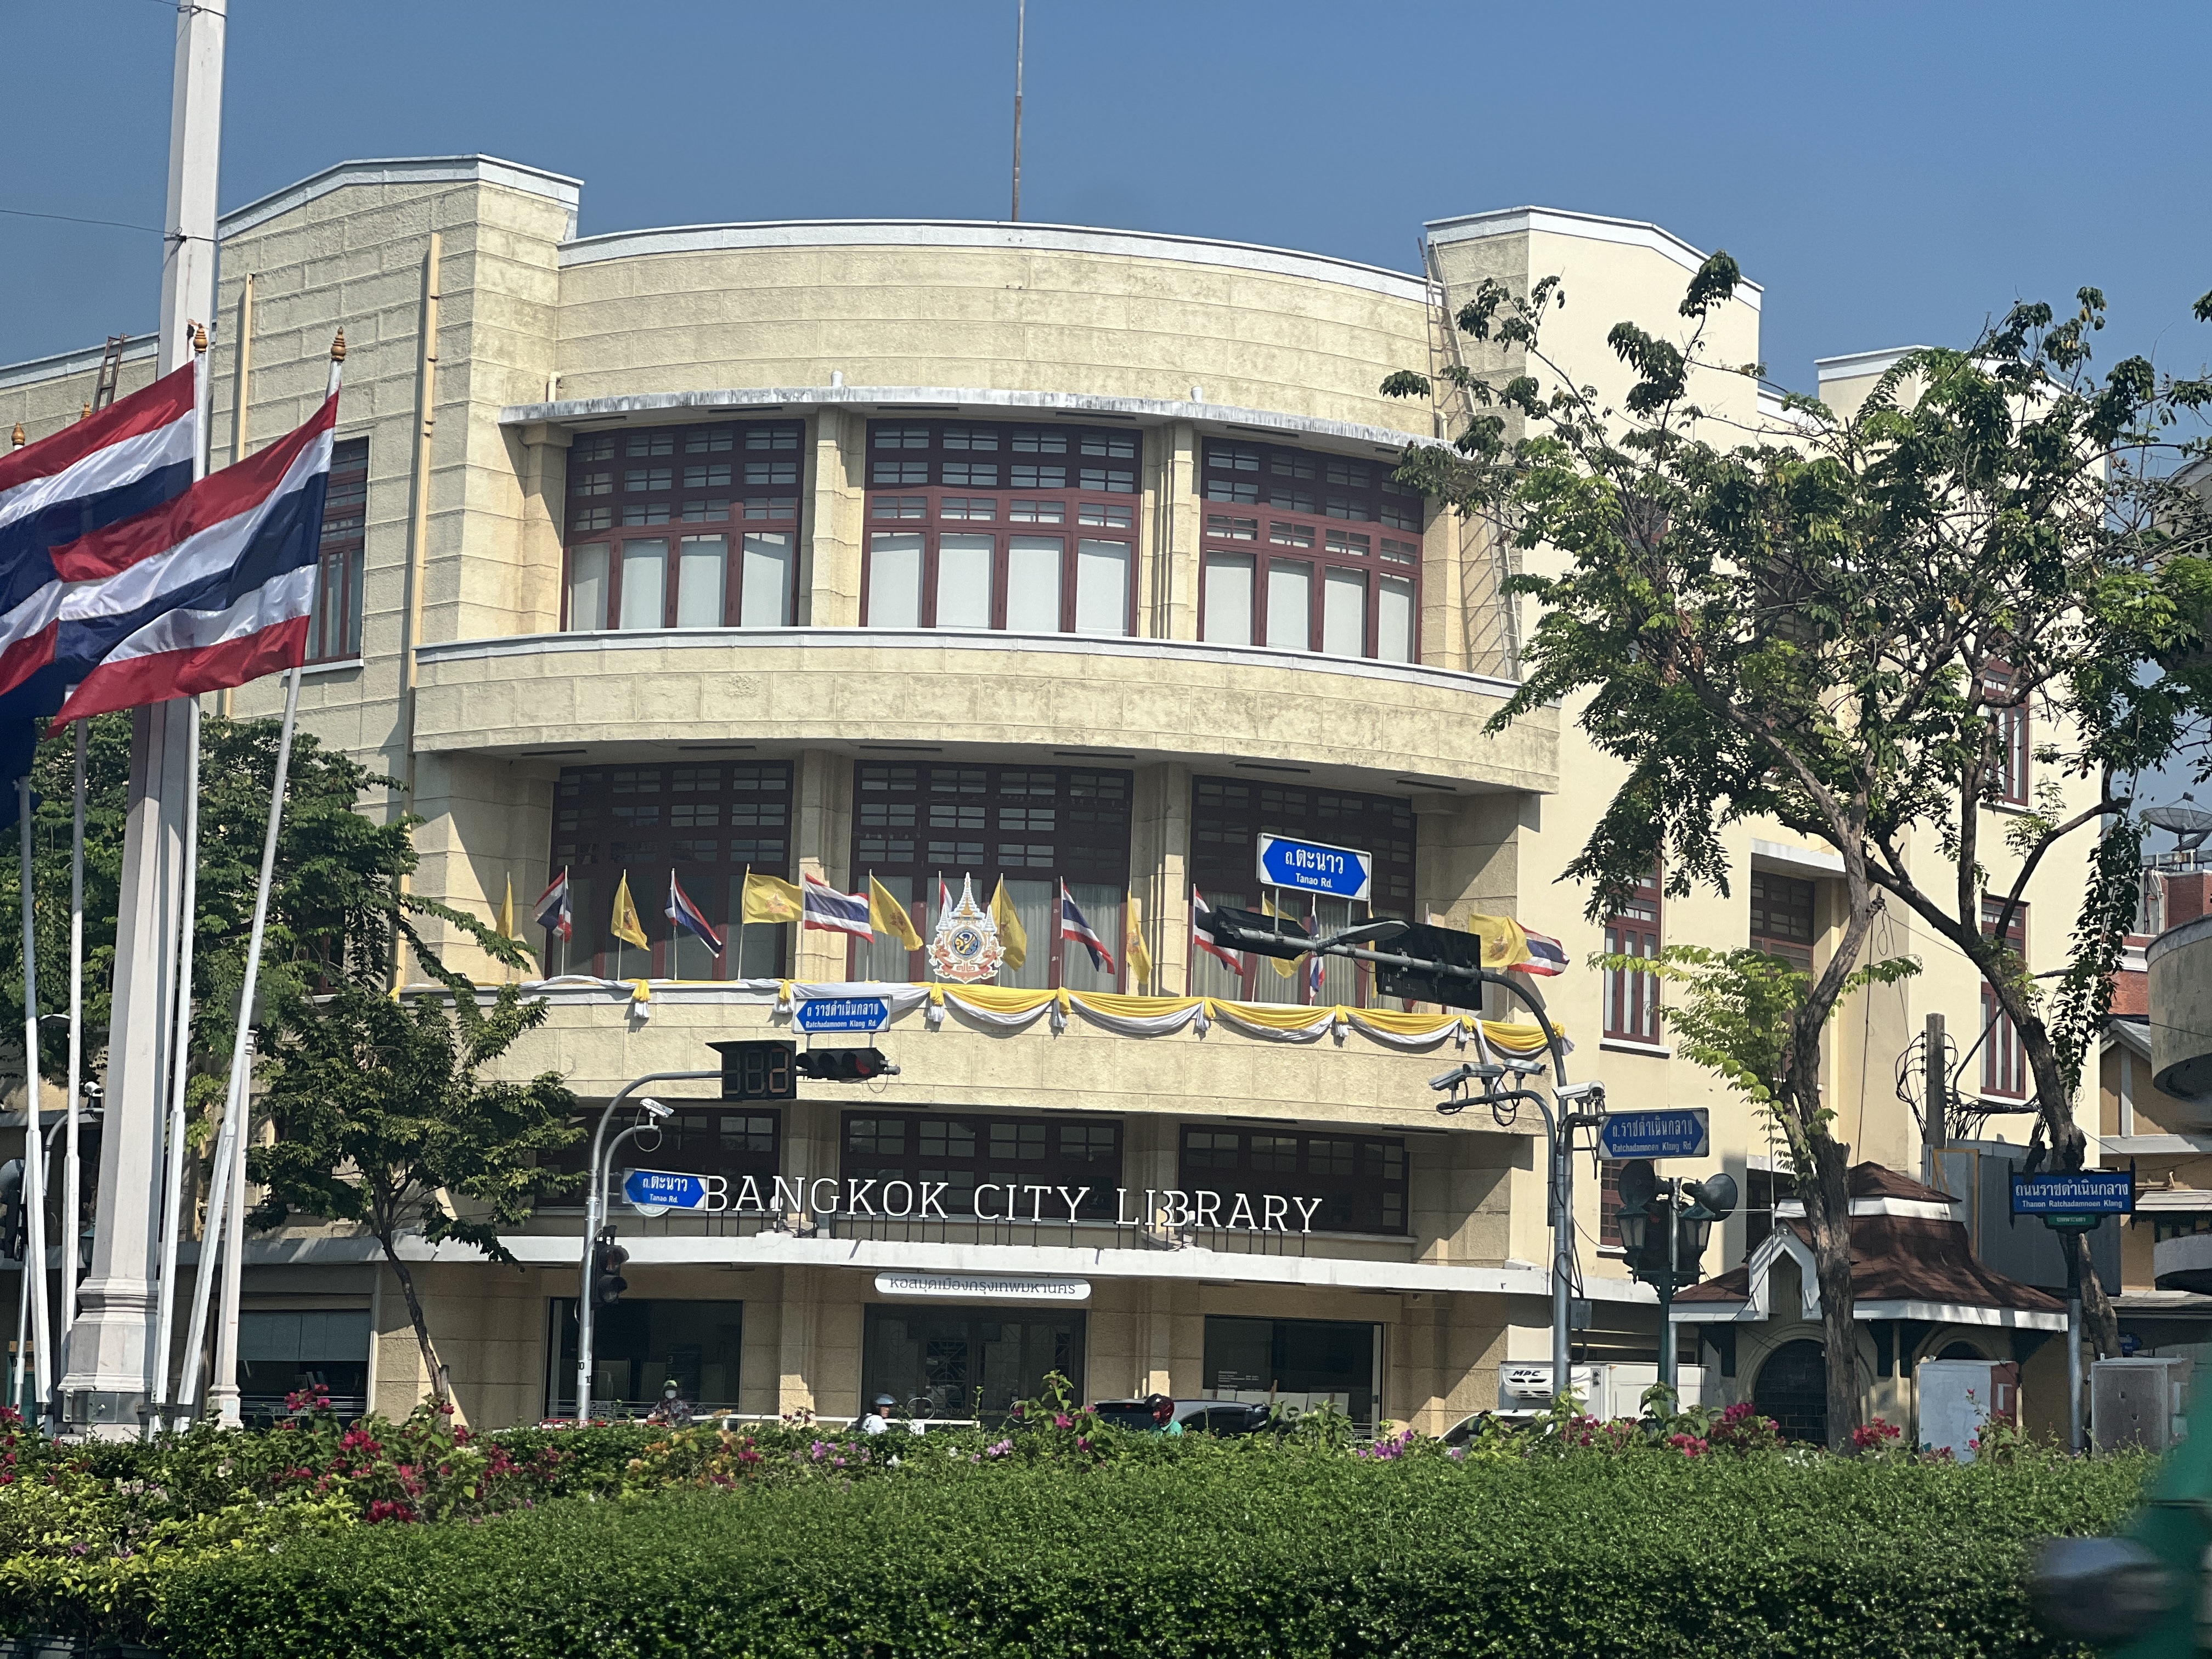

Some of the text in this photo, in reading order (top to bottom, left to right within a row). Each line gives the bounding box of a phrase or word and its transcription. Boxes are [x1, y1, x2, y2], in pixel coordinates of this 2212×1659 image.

[1285, 849, 1344, 874] ถ.ตะนาว
[1296, 873, 1333, 888] Tanao Rd.
[1612, 1143, 1659, 1153] Ratchadamnoen
[1662, 1142, 1679, 1152] Klang
[2016, 1179, 2129, 1196] ถนนราชดำเนินกลาง
[650, 1193, 667, 1202] Tanao
[707, 1175, 1323, 1233] BANGKOK CITY LIBRARY
[2103, 1200, 2123, 1208] Klang
